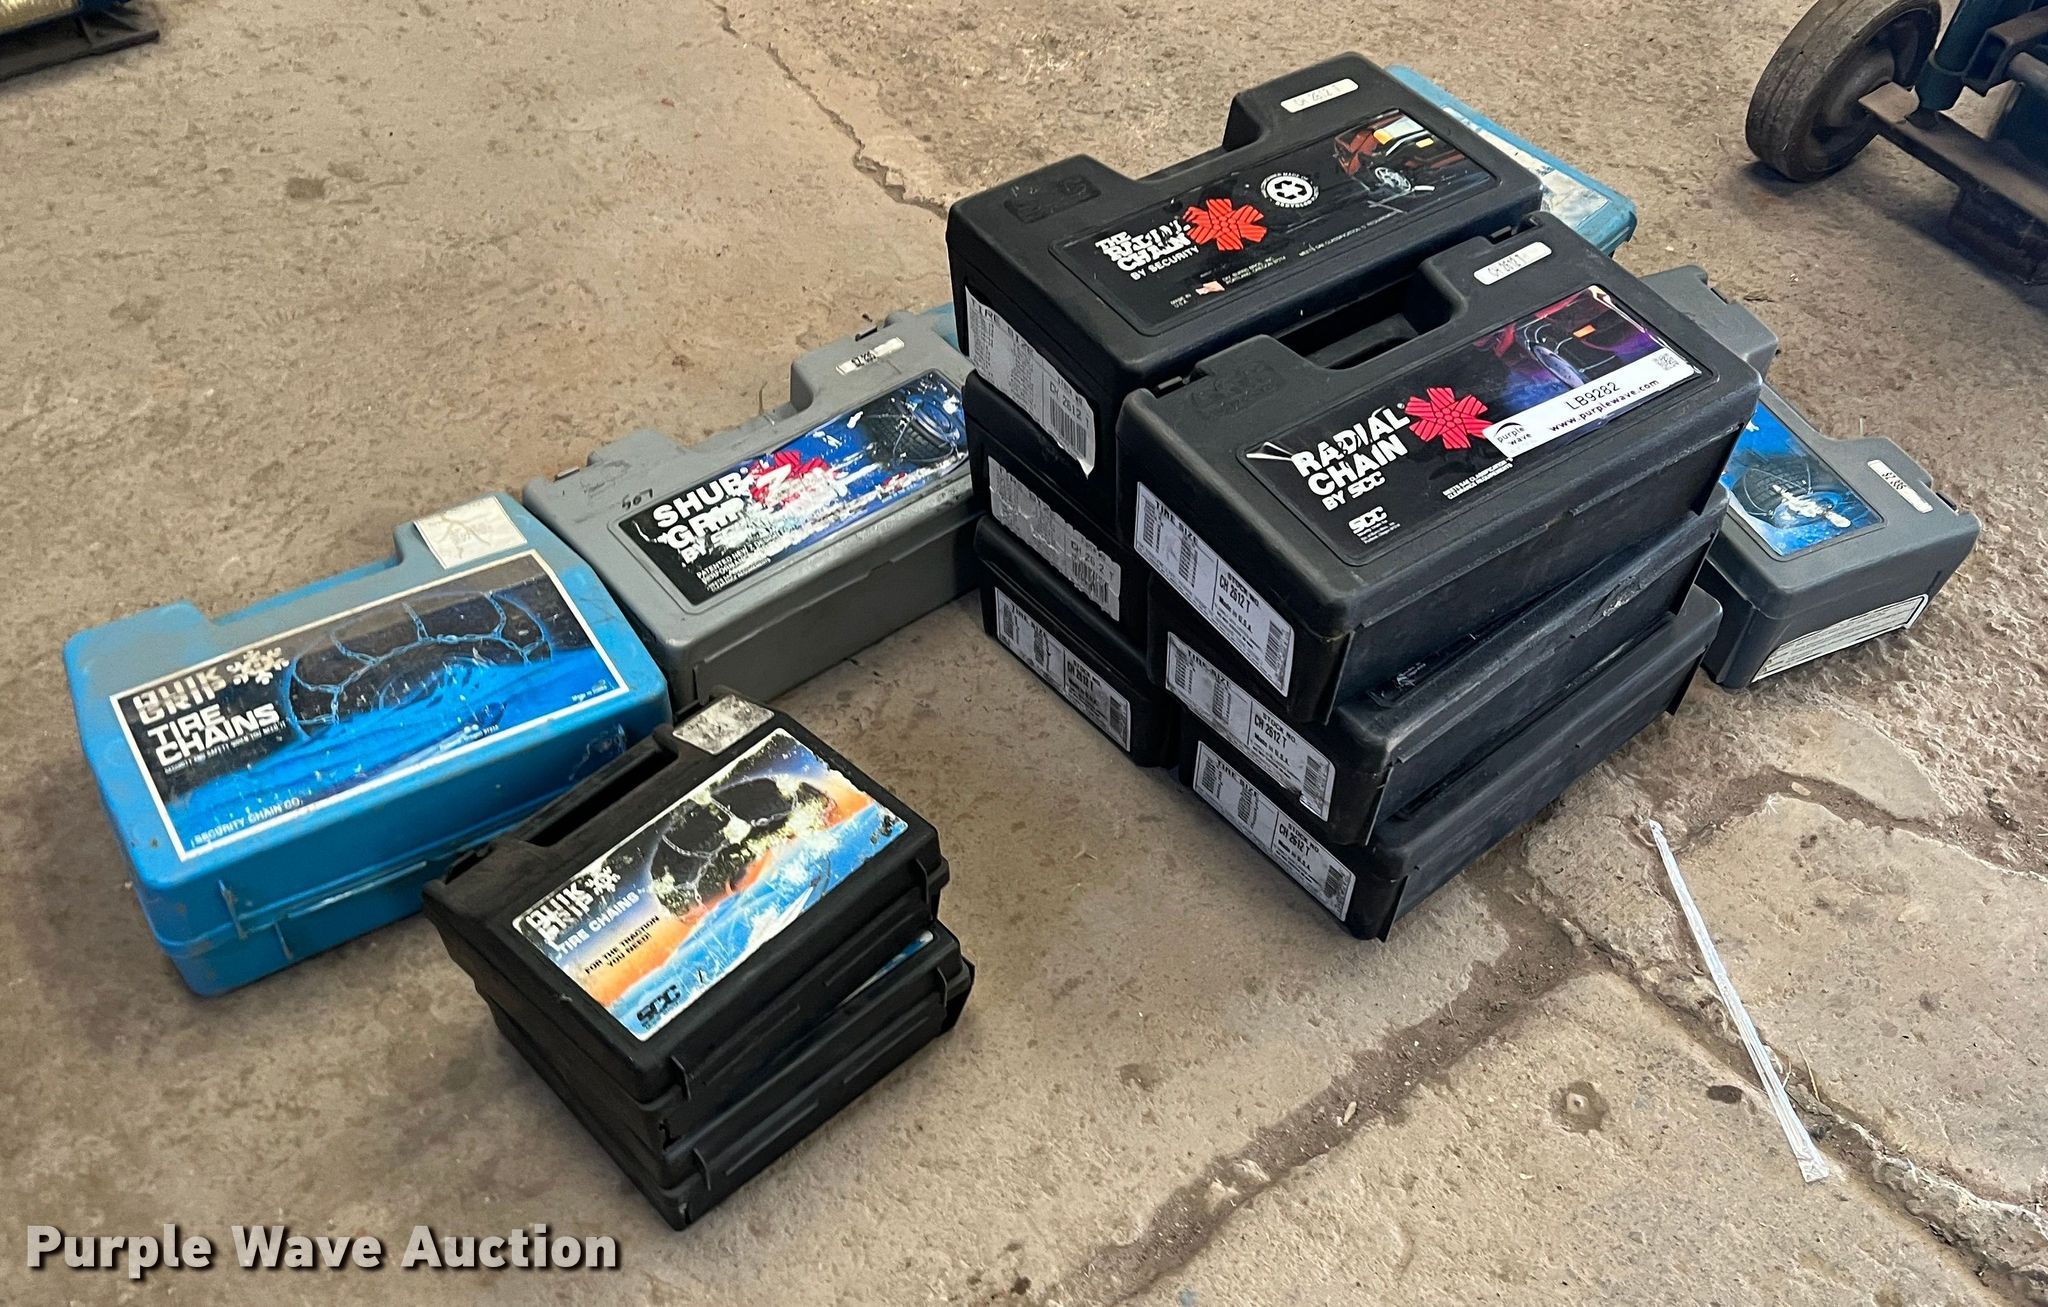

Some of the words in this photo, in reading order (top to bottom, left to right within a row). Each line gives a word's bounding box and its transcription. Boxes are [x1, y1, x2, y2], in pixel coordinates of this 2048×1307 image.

[1130, 268, 1146, 280] BY
[1148, 246, 1199, 273] SECURITY
[1062, 393, 1082, 423] 2612
[1550, 379, 1660, 412] www.purplewave.com
[1565, 381, 1621, 411] LB9282
[1290, 407, 1411, 478] RADIAL
[1497, 426, 1525, 443] purple
[1509, 432, 1532, 446] wave
[1308, 434, 1408, 495] CHAIN
[1321, 490, 1346, 511] BY
[1347, 471, 1386, 499] SCC
[1155, 499, 1175, 526] TIRE
[1178, 520, 1198, 546] SIZE
[1349, 506, 1387, 534] SCC
[681, 538, 707, 564] BY
[1085, 550, 1104, 575] 262
[1219, 573, 1228, 593] CH
[1229, 583, 1244, 609] 2612
[1244, 598, 1250, 615] T
[1227, 571, 1248, 597] STOCK
[1187, 649, 1207, 670] TIRE
[147, 703, 226, 747] TIRE
[155, 702, 280, 767] CHAINS
[1254, 712, 1264, 731] CH
[1264, 721, 1281, 746] 2612
[1281, 735, 1287, 751] T
[1262, 711, 1283, 734] STOCK
[1216, 759, 1236, 780] TIRE
[194, 817, 245, 845] SECURITY
[248, 802, 283, 824] CHAIN
[1278, 822, 1289, 839] CH
[1288, 831, 1304, 853] 2612
[1304, 844, 1311, 858] T
[1287, 822, 1308, 844] STOCK
[560, 929, 590, 954] TIRE
[588, 891, 640, 932] CHAINS
[584, 959, 603, 975] FOR
[603, 947, 619, 960] THE
[620, 915, 660, 947] TRACTION
[607, 952, 625, 967] YOU
[626, 932, 652, 954] NEED!
[636, 984, 681, 1022] SCC
